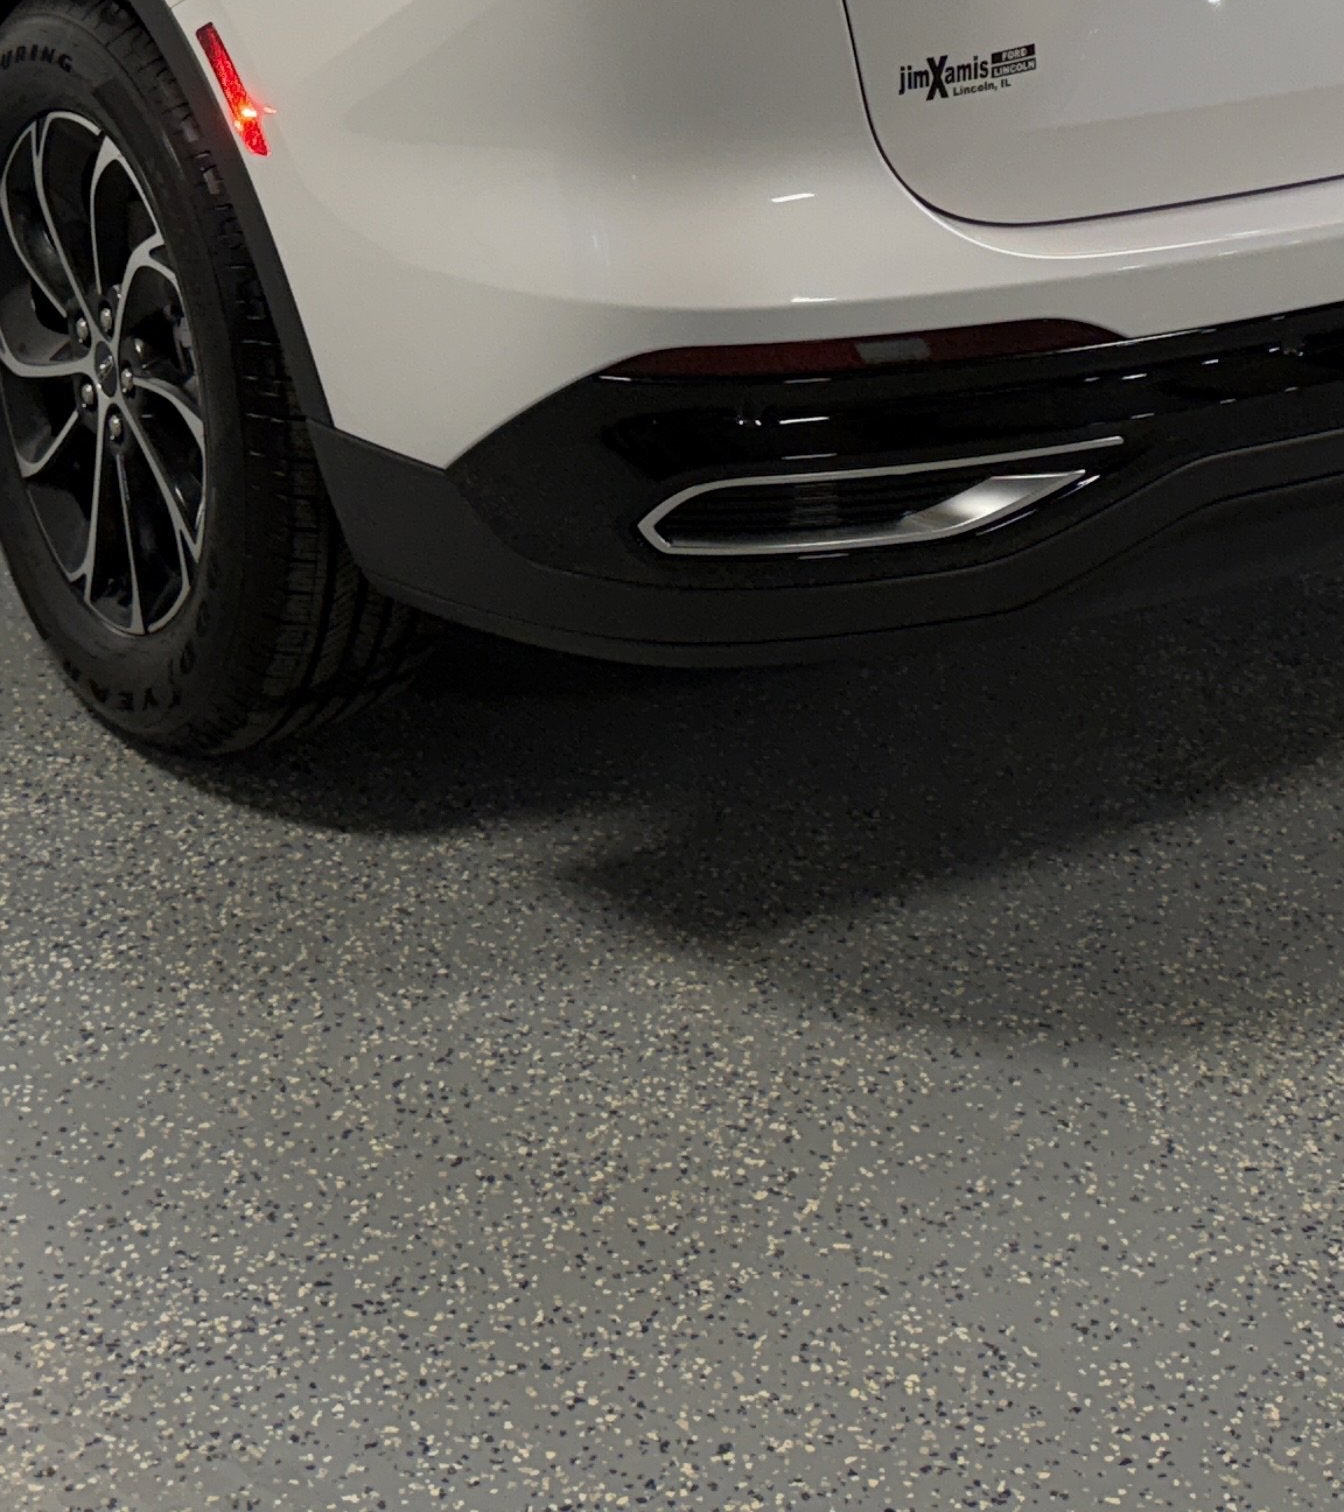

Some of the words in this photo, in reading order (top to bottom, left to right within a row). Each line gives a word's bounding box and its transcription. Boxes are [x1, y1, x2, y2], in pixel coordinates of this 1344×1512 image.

[1001, 46, 1028, 62] FORD
[992, 59, 1036, 78] LINCOLN
[1000, 77, 1012, 89] IL
